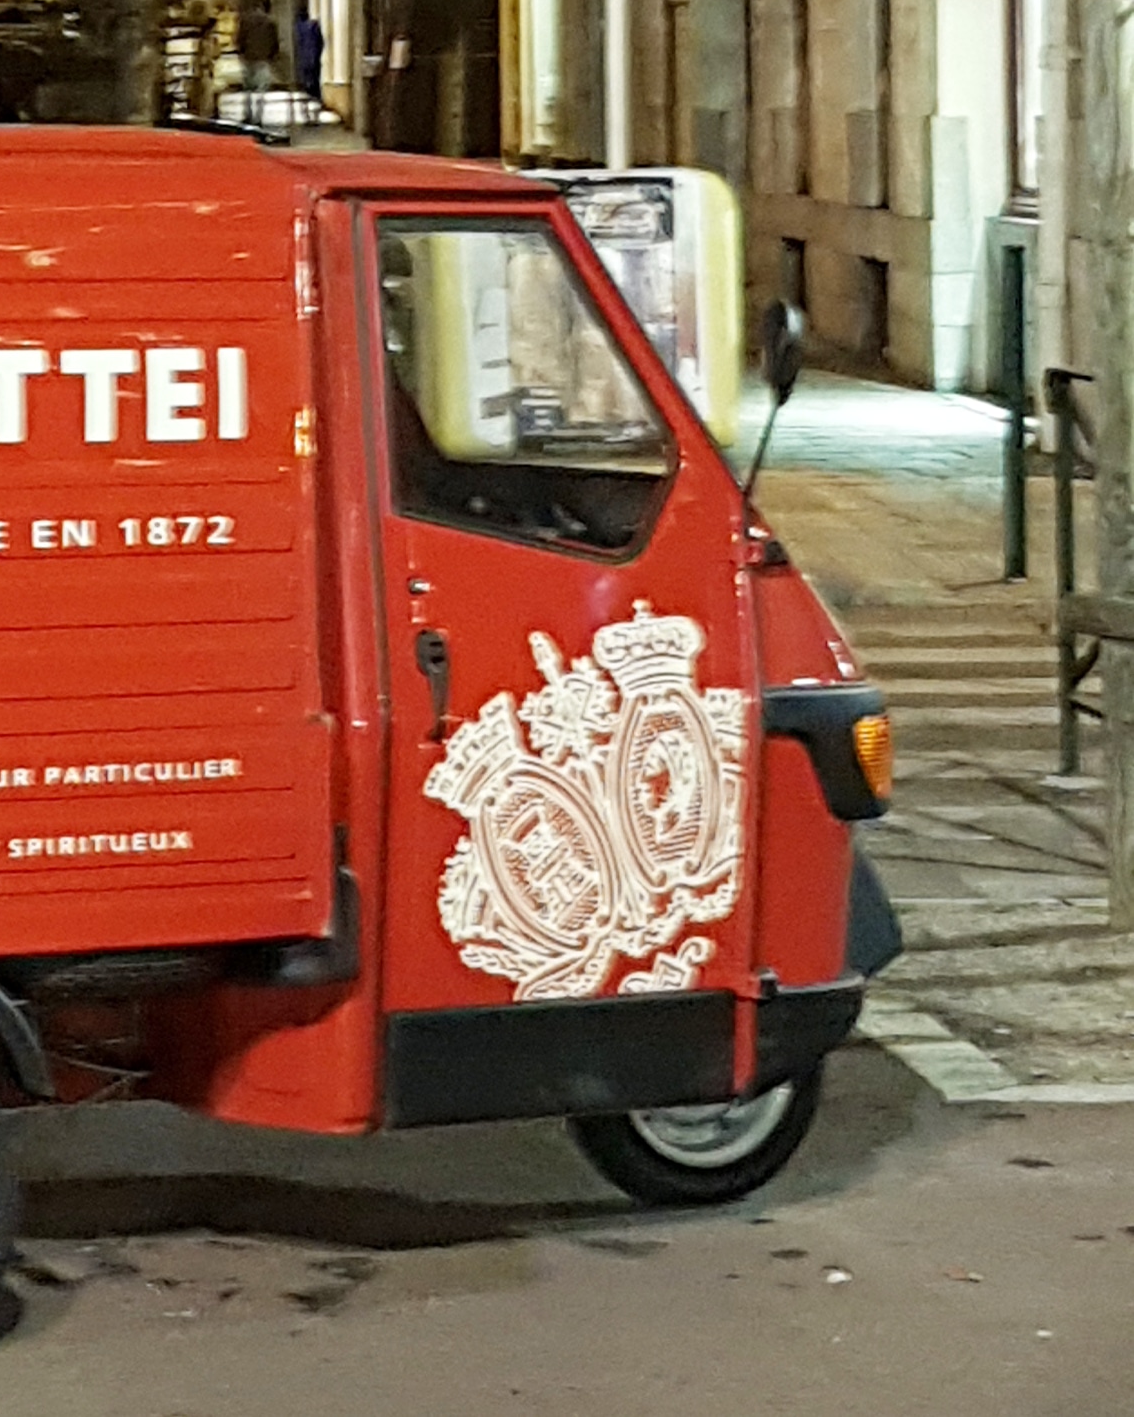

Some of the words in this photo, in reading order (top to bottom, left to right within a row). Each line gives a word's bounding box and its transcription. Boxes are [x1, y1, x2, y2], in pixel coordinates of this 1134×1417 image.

[31, 518, 97, 549] EN
[119, 515, 236, 547] 1872
[44, 758, 243, 785] PARTICULIER
[8, 831, 193, 859] SPIRITUEUX
